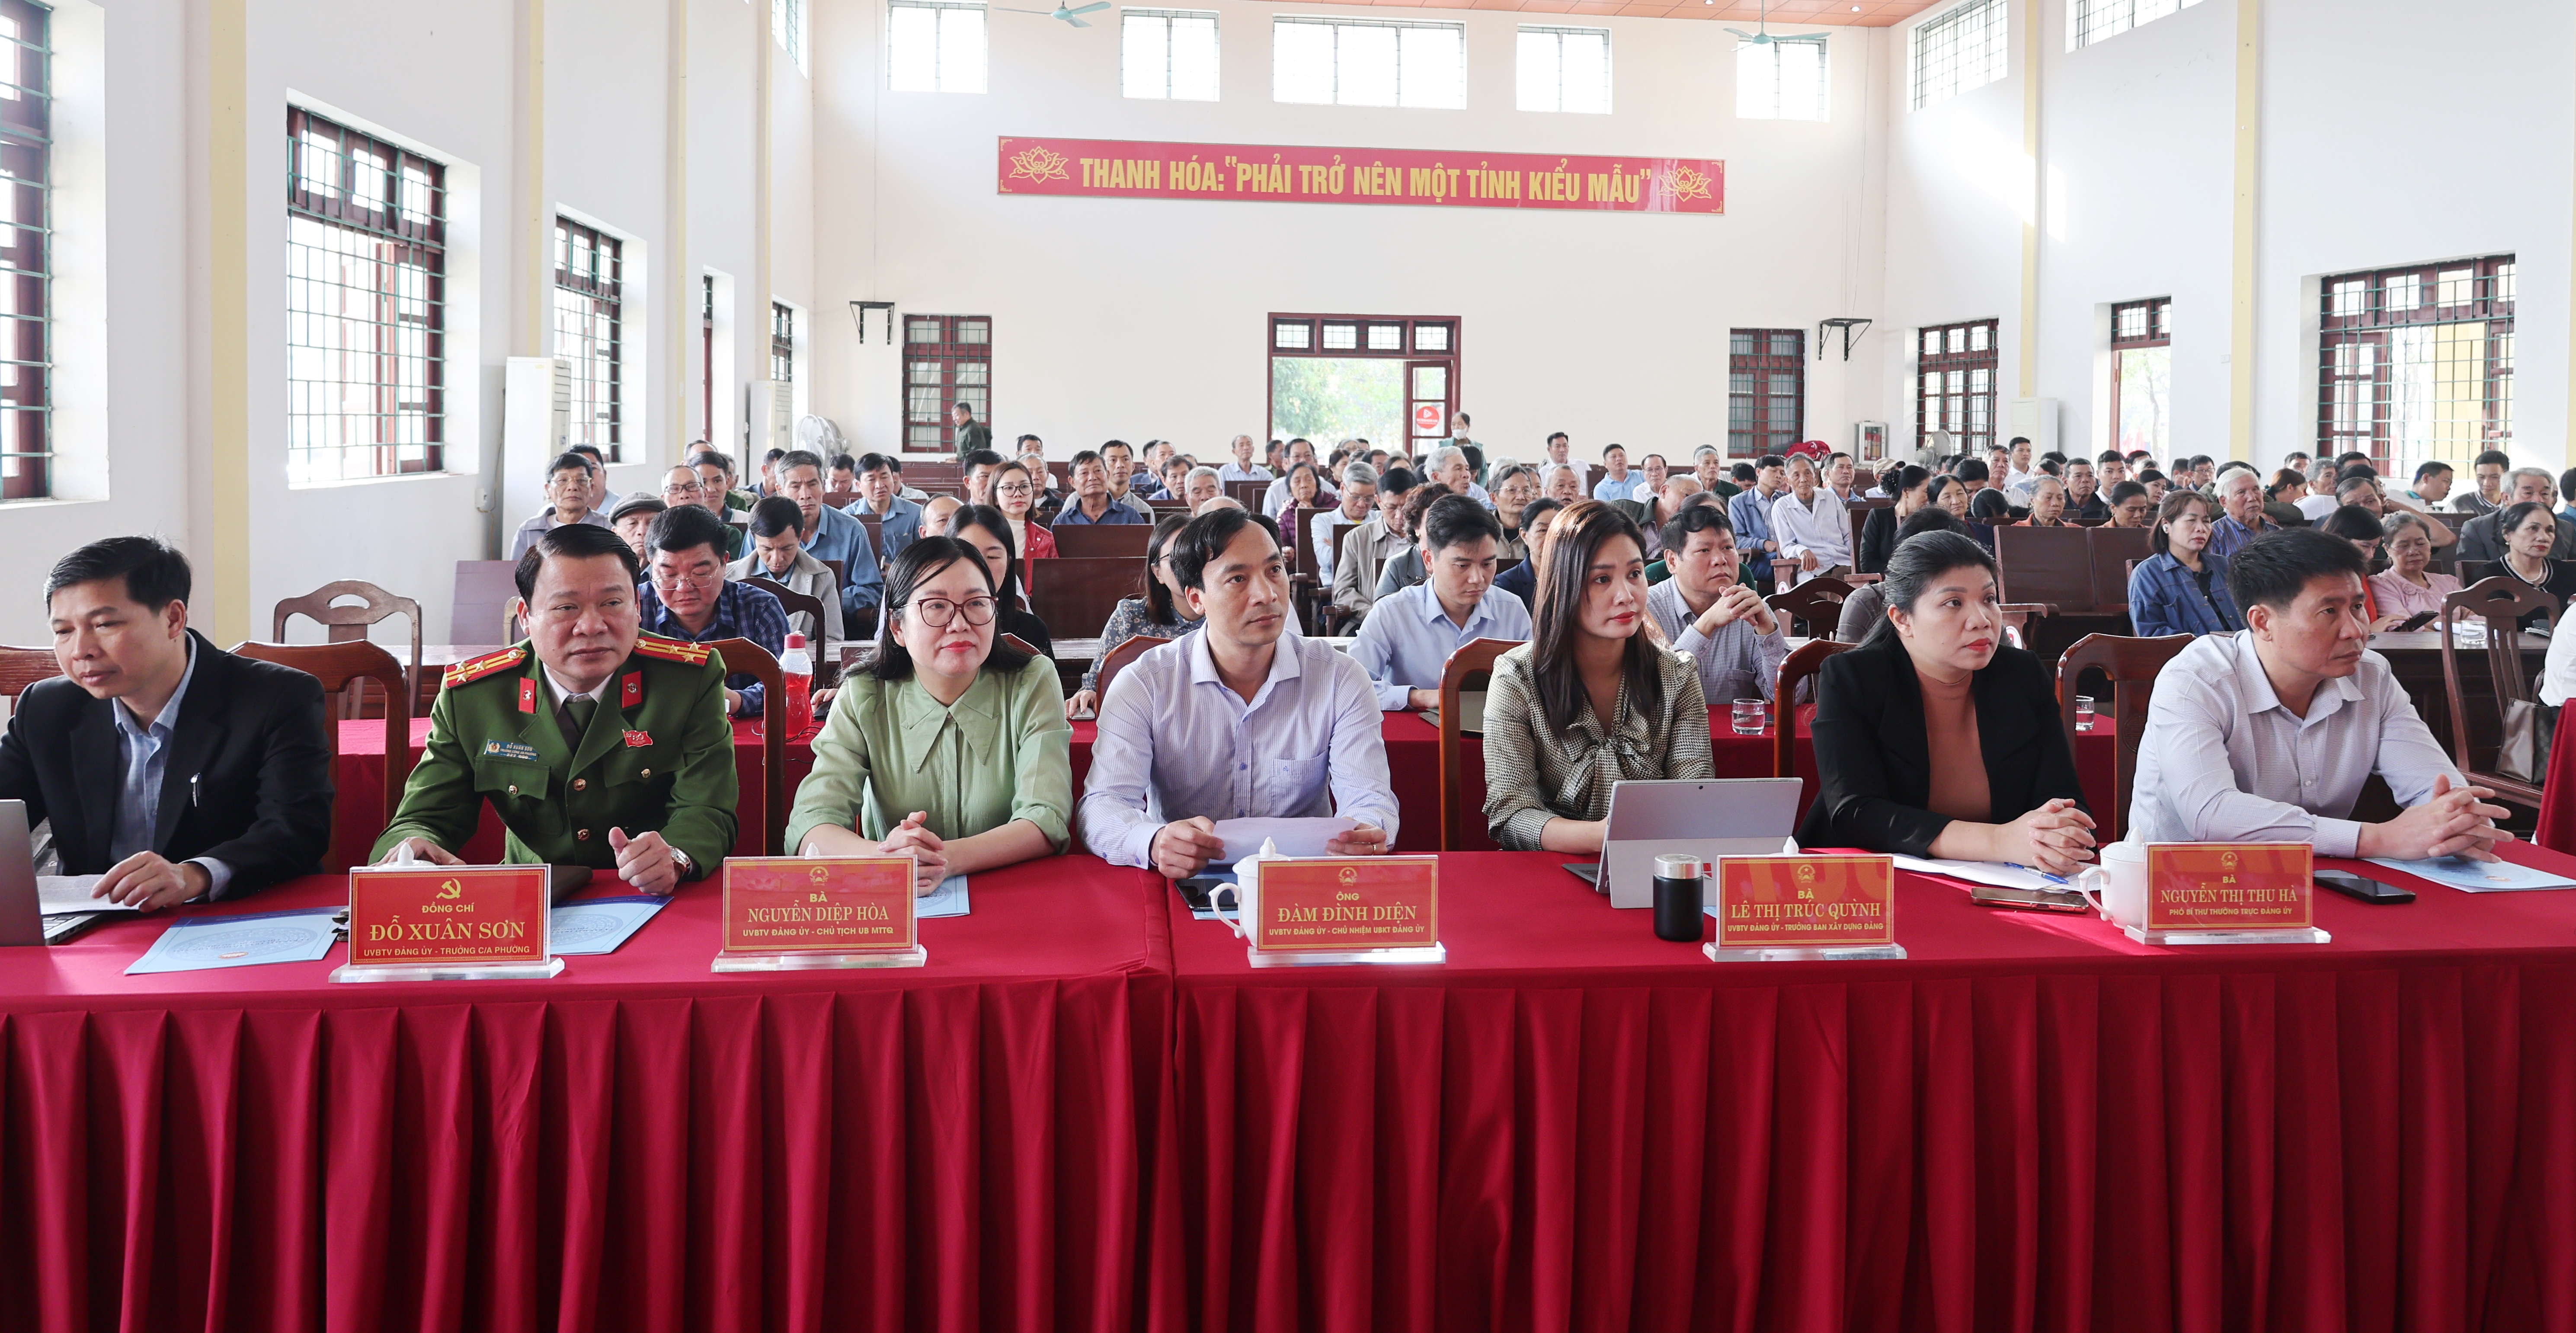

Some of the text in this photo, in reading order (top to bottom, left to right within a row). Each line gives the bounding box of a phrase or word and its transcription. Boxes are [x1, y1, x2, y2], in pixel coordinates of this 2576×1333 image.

[1080, 158, 1160, 189] THANH
[1170, 155, 1224, 191] HÓA:
[1299, 155, 1346, 195] TRỞ
[1354, 161, 1402, 196] NÊN
[1410, 163, 1460, 202] MỘT
[1467, 161, 1520, 199] TỈNH
[1529, 158, 1580, 202] KIỂU
[2222, 874, 2236, 883] BÀ
[810, 891, 827, 902] BÀ
[1336, 892, 1360, 901] ÔNG
[1798, 888, 1814, 899] BÀ
[2160, 882, 2298, 905] NGUYỄN THỊ THU HÀ
[422, 902, 474, 913] ĐỒNG CHÍ
[748, 900, 889, 924] NGUYỄN DIỆP HÒA
[1278, 901, 1417, 924] ĐÀM ĐÌNH DIỆN
[1731, 899, 1881, 921] LÊ THỊ TRÚC QUỲNH
[2169, 907, 2185, 915] PHÓ
[2210, 906, 2239, 915] THƯỜNG
[370, 915, 525, 941] ĐỖ XUÂN SƠN
[771, 926, 797, 936] ĐẢNG
[799, 926, 810, 935] ỦY
[816, 925, 835, 935] CHỦ
[837, 927, 855, 937] TỊCH
[1293, 927, 1315, 935] ĐẢNG
[1317, 926, 1326, 934] ỦY
[1332, 925, 1347, 934] CHỦ
[1349, 925, 1371, 935] NHIỆM
[1392, 924, 1414, 933] ĐẢNG
[1415, 924, 1424, 933] ỦY
[1750, 922, 1770, 931] ĐẢNG
[1771, 922, 1780, 931] ỦY
[1828, 922, 1842, 930] XÂY
[1843, 923, 1862, 932] DỰNG
[394, 946, 419, 956] ĐẢNG
[421, 946, 432, 955] ỦY
[440, 945, 476, 954] TRƯỞNG
[495, 945, 530, 953] PHƯỜNG
